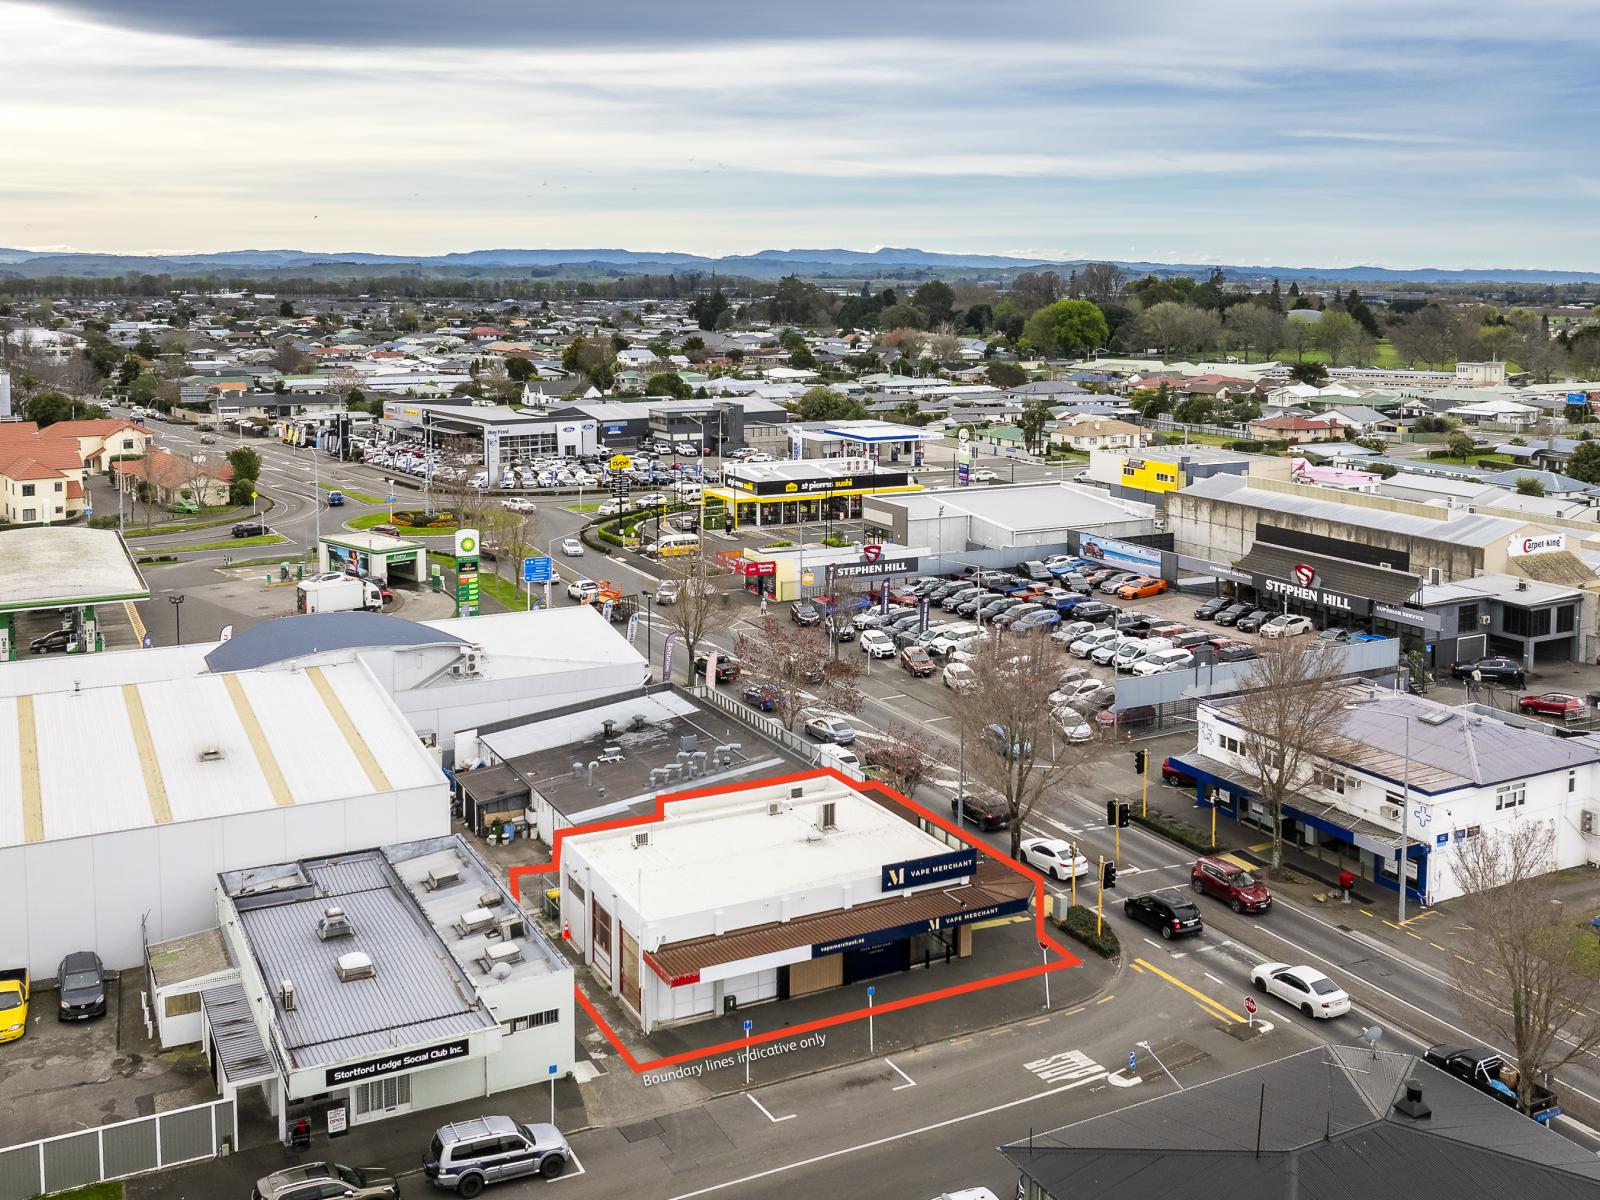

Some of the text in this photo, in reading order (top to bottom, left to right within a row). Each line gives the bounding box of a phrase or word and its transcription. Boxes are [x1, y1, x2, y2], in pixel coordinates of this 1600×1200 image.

[835, 478, 852, 487] sushi
[1523, 539, 1544, 553] Carpet
[837, 562, 907, 576] STEPHEN HILL
[1265, 579, 1351, 610] STEPHEN HILL
[1376, 605, 1402, 616] SUPERIOR
[910, 868, 930, 878] VAPE
[932, 859, 973, 873] MERCHANT
[945, 916, 962, 924] VAPE
[964, 908, 999, 919] MERCHANT
[820, 937, 865, 952] vapemerchant.nz
[1245, 998, 1256, 1010] STOP
[334, 1046, 463, 1080] Stortford Lodge Social Club Inc.
